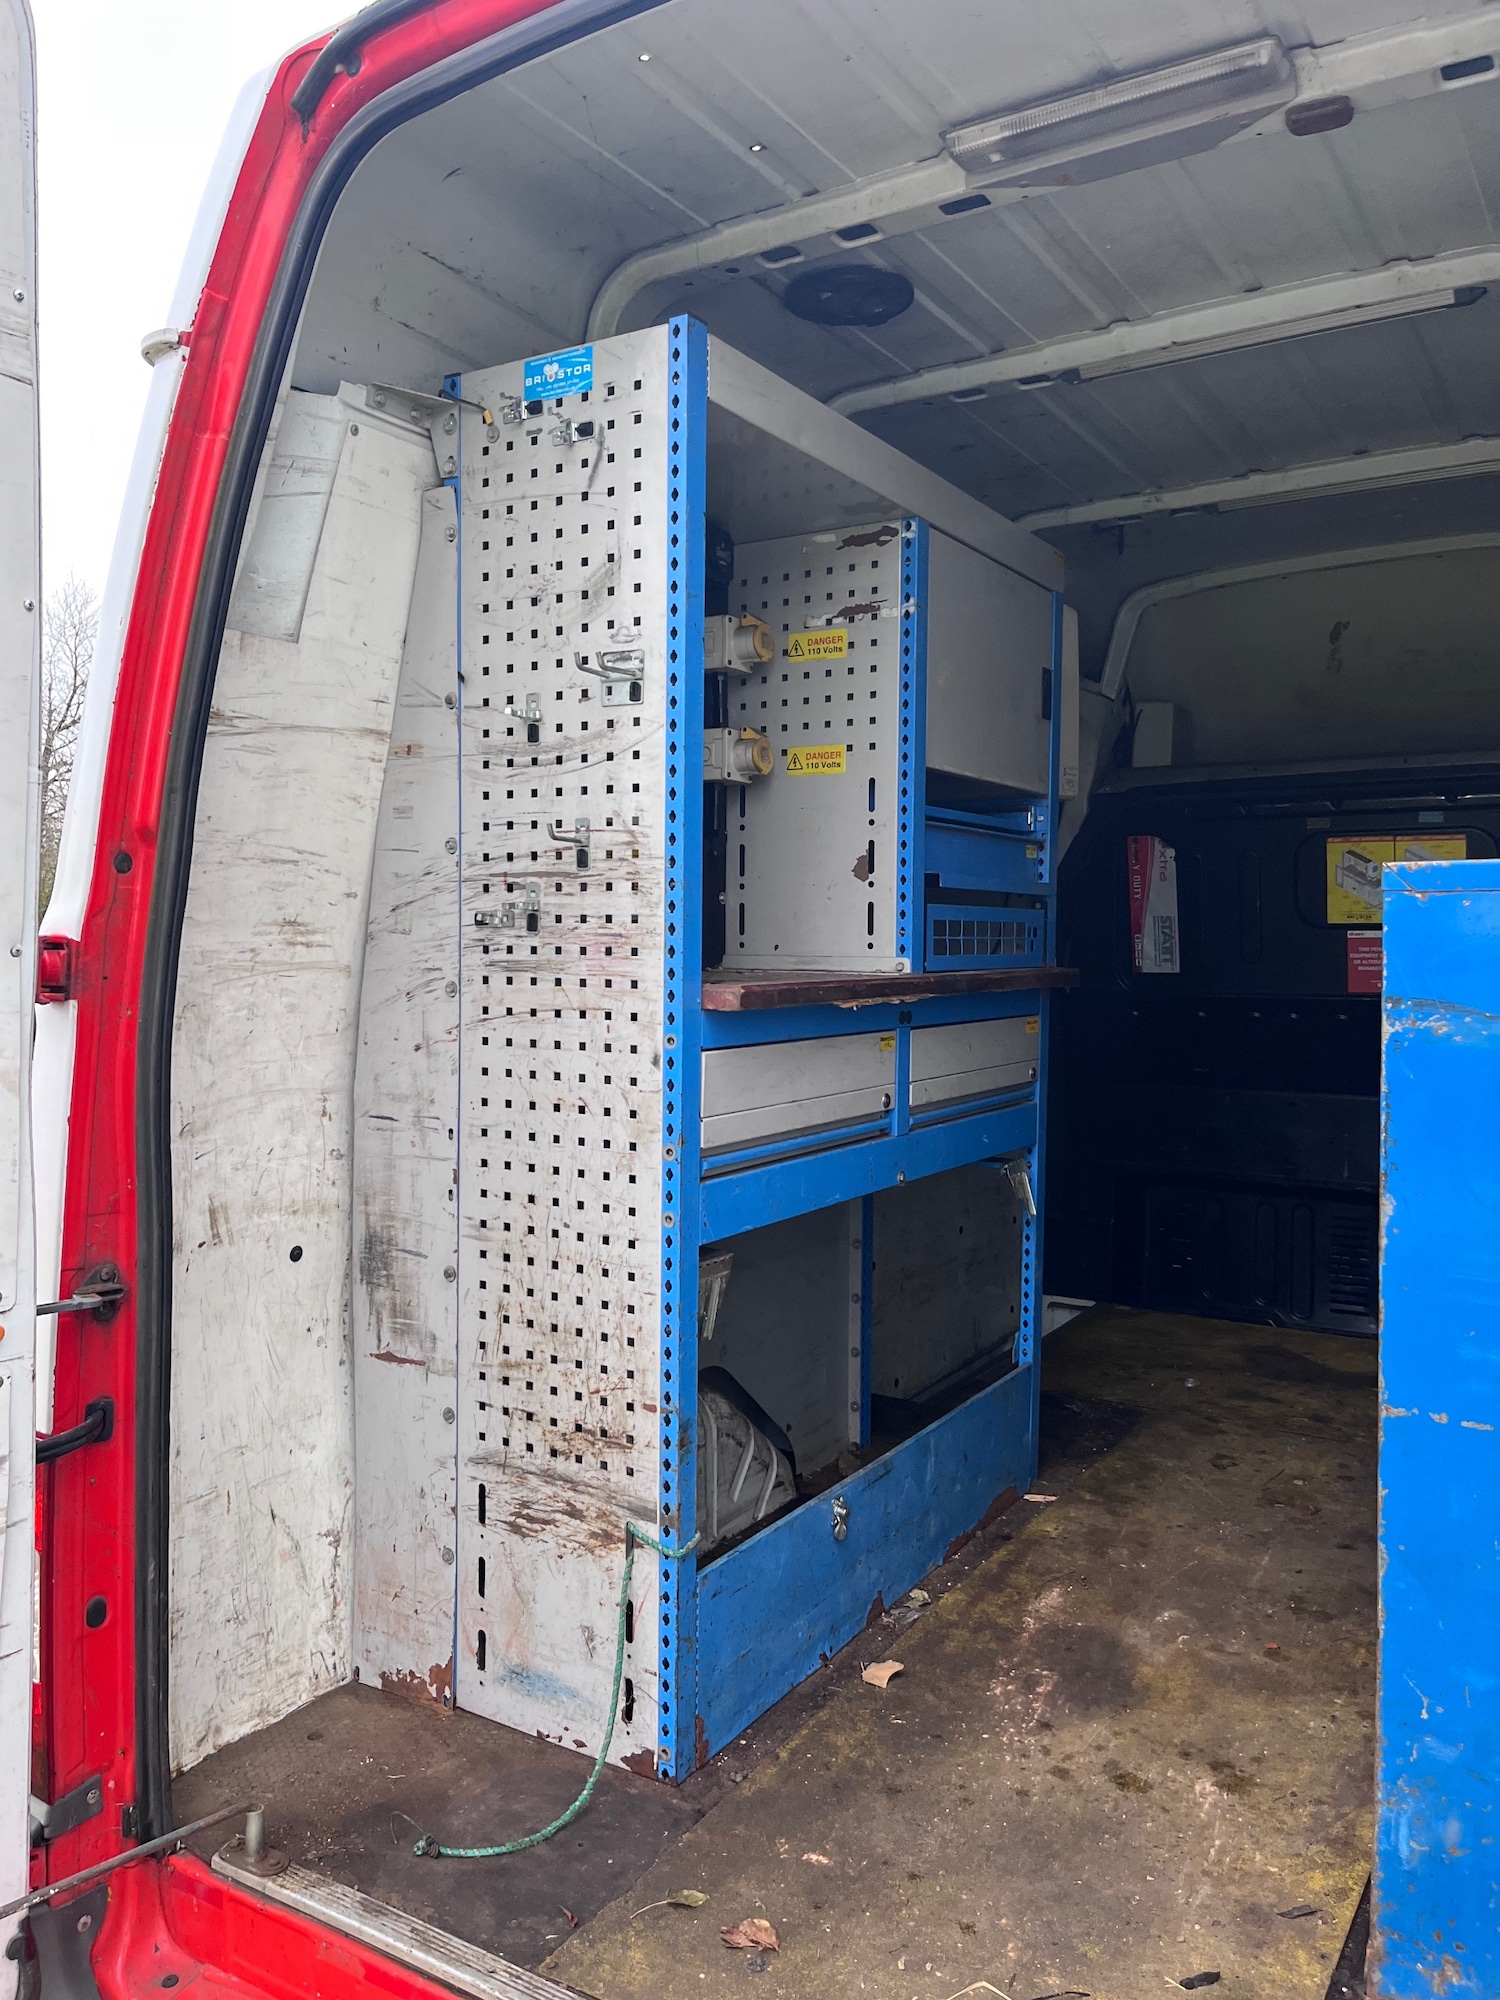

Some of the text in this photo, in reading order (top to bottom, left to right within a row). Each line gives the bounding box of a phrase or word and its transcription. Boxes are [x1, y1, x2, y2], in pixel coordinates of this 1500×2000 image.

[807, 636, 843, 647] DANGER
[808, 646, 843, 655] 110 Volts
[805, 751, 841, 761] DANGER
[821, 761, 841, 769] Volts
[1132, 875, 1142, 899] DUTY
